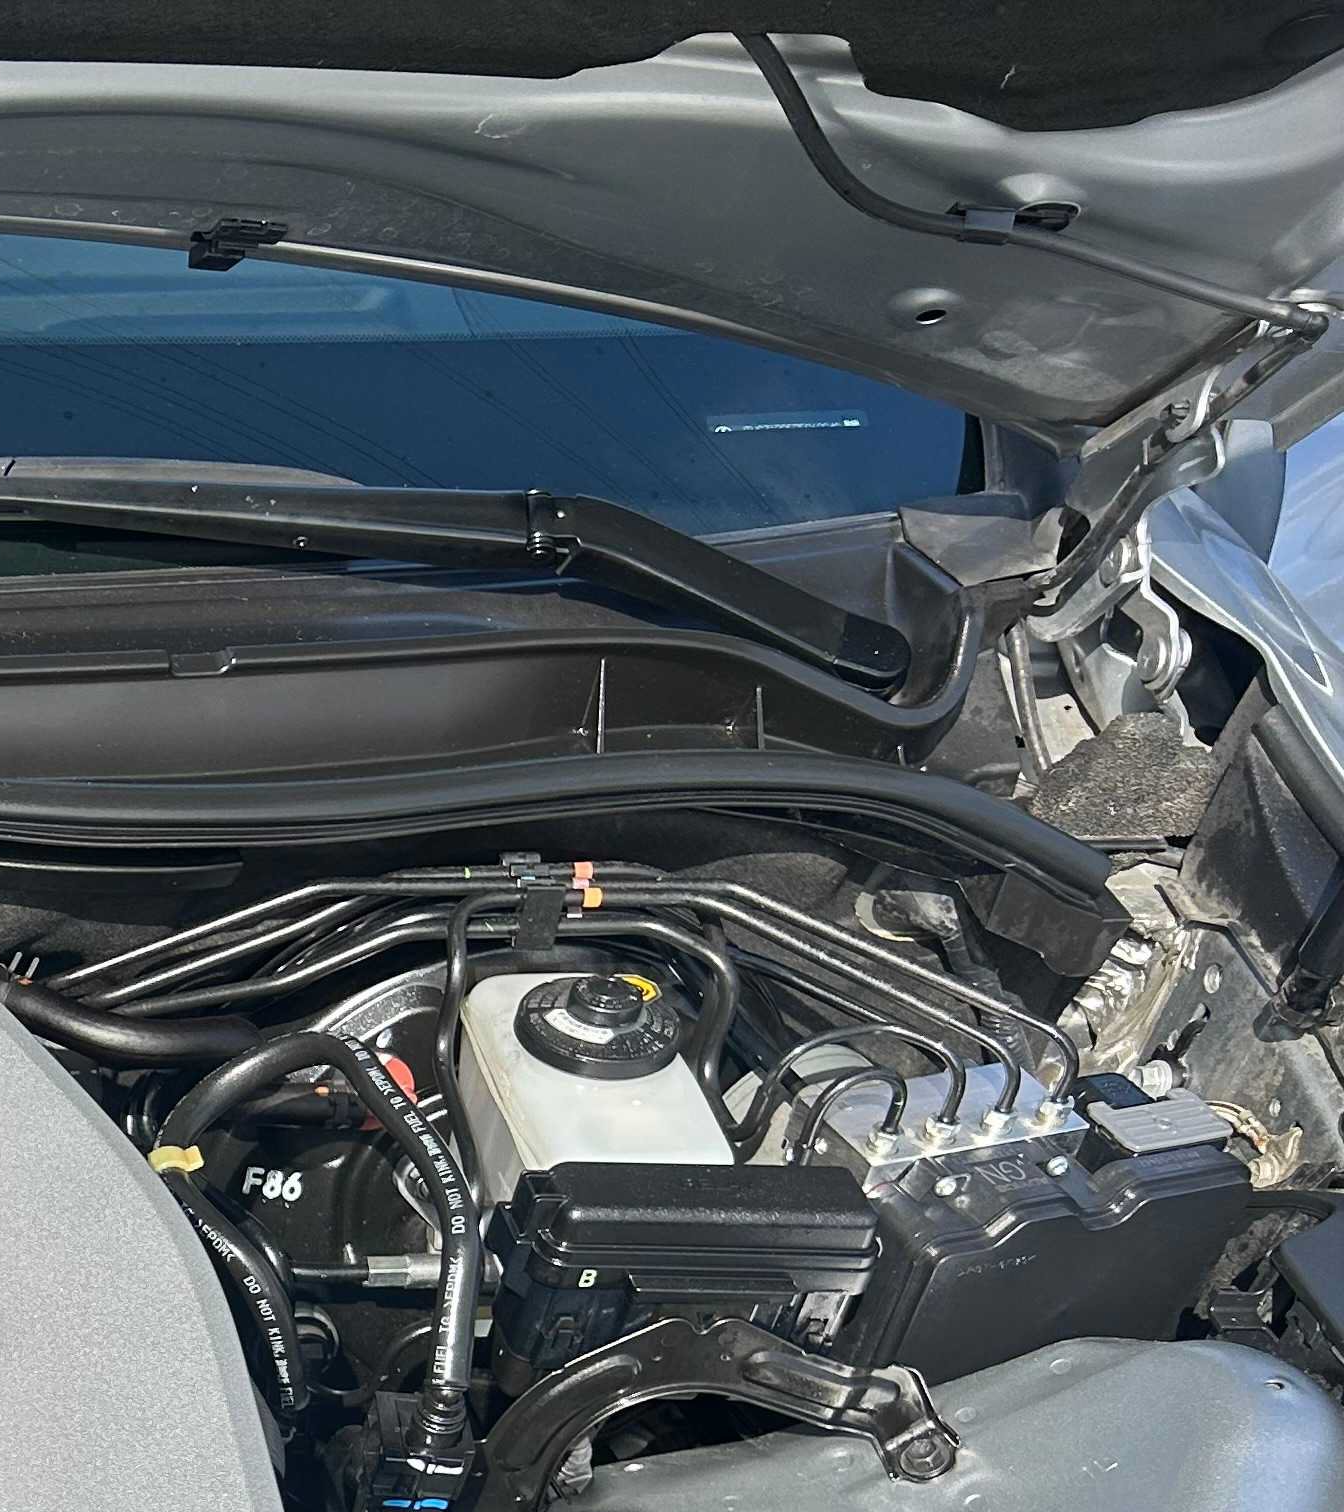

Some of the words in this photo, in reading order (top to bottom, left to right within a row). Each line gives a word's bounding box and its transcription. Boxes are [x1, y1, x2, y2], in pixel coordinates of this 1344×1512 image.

[389, 1096, 407, 1110] TO
[403, 1110, 427, 1135] FUEL
[242, 1166, 303, 1202] F86
[446, 1188, 464, 1210] NOT
[451, 1215, 466, 1235] DO
[578, 1269, 597, 1288] B
[243, 1275, 262, 1295] DO
[256, 1298, 276, 1323] NOT
